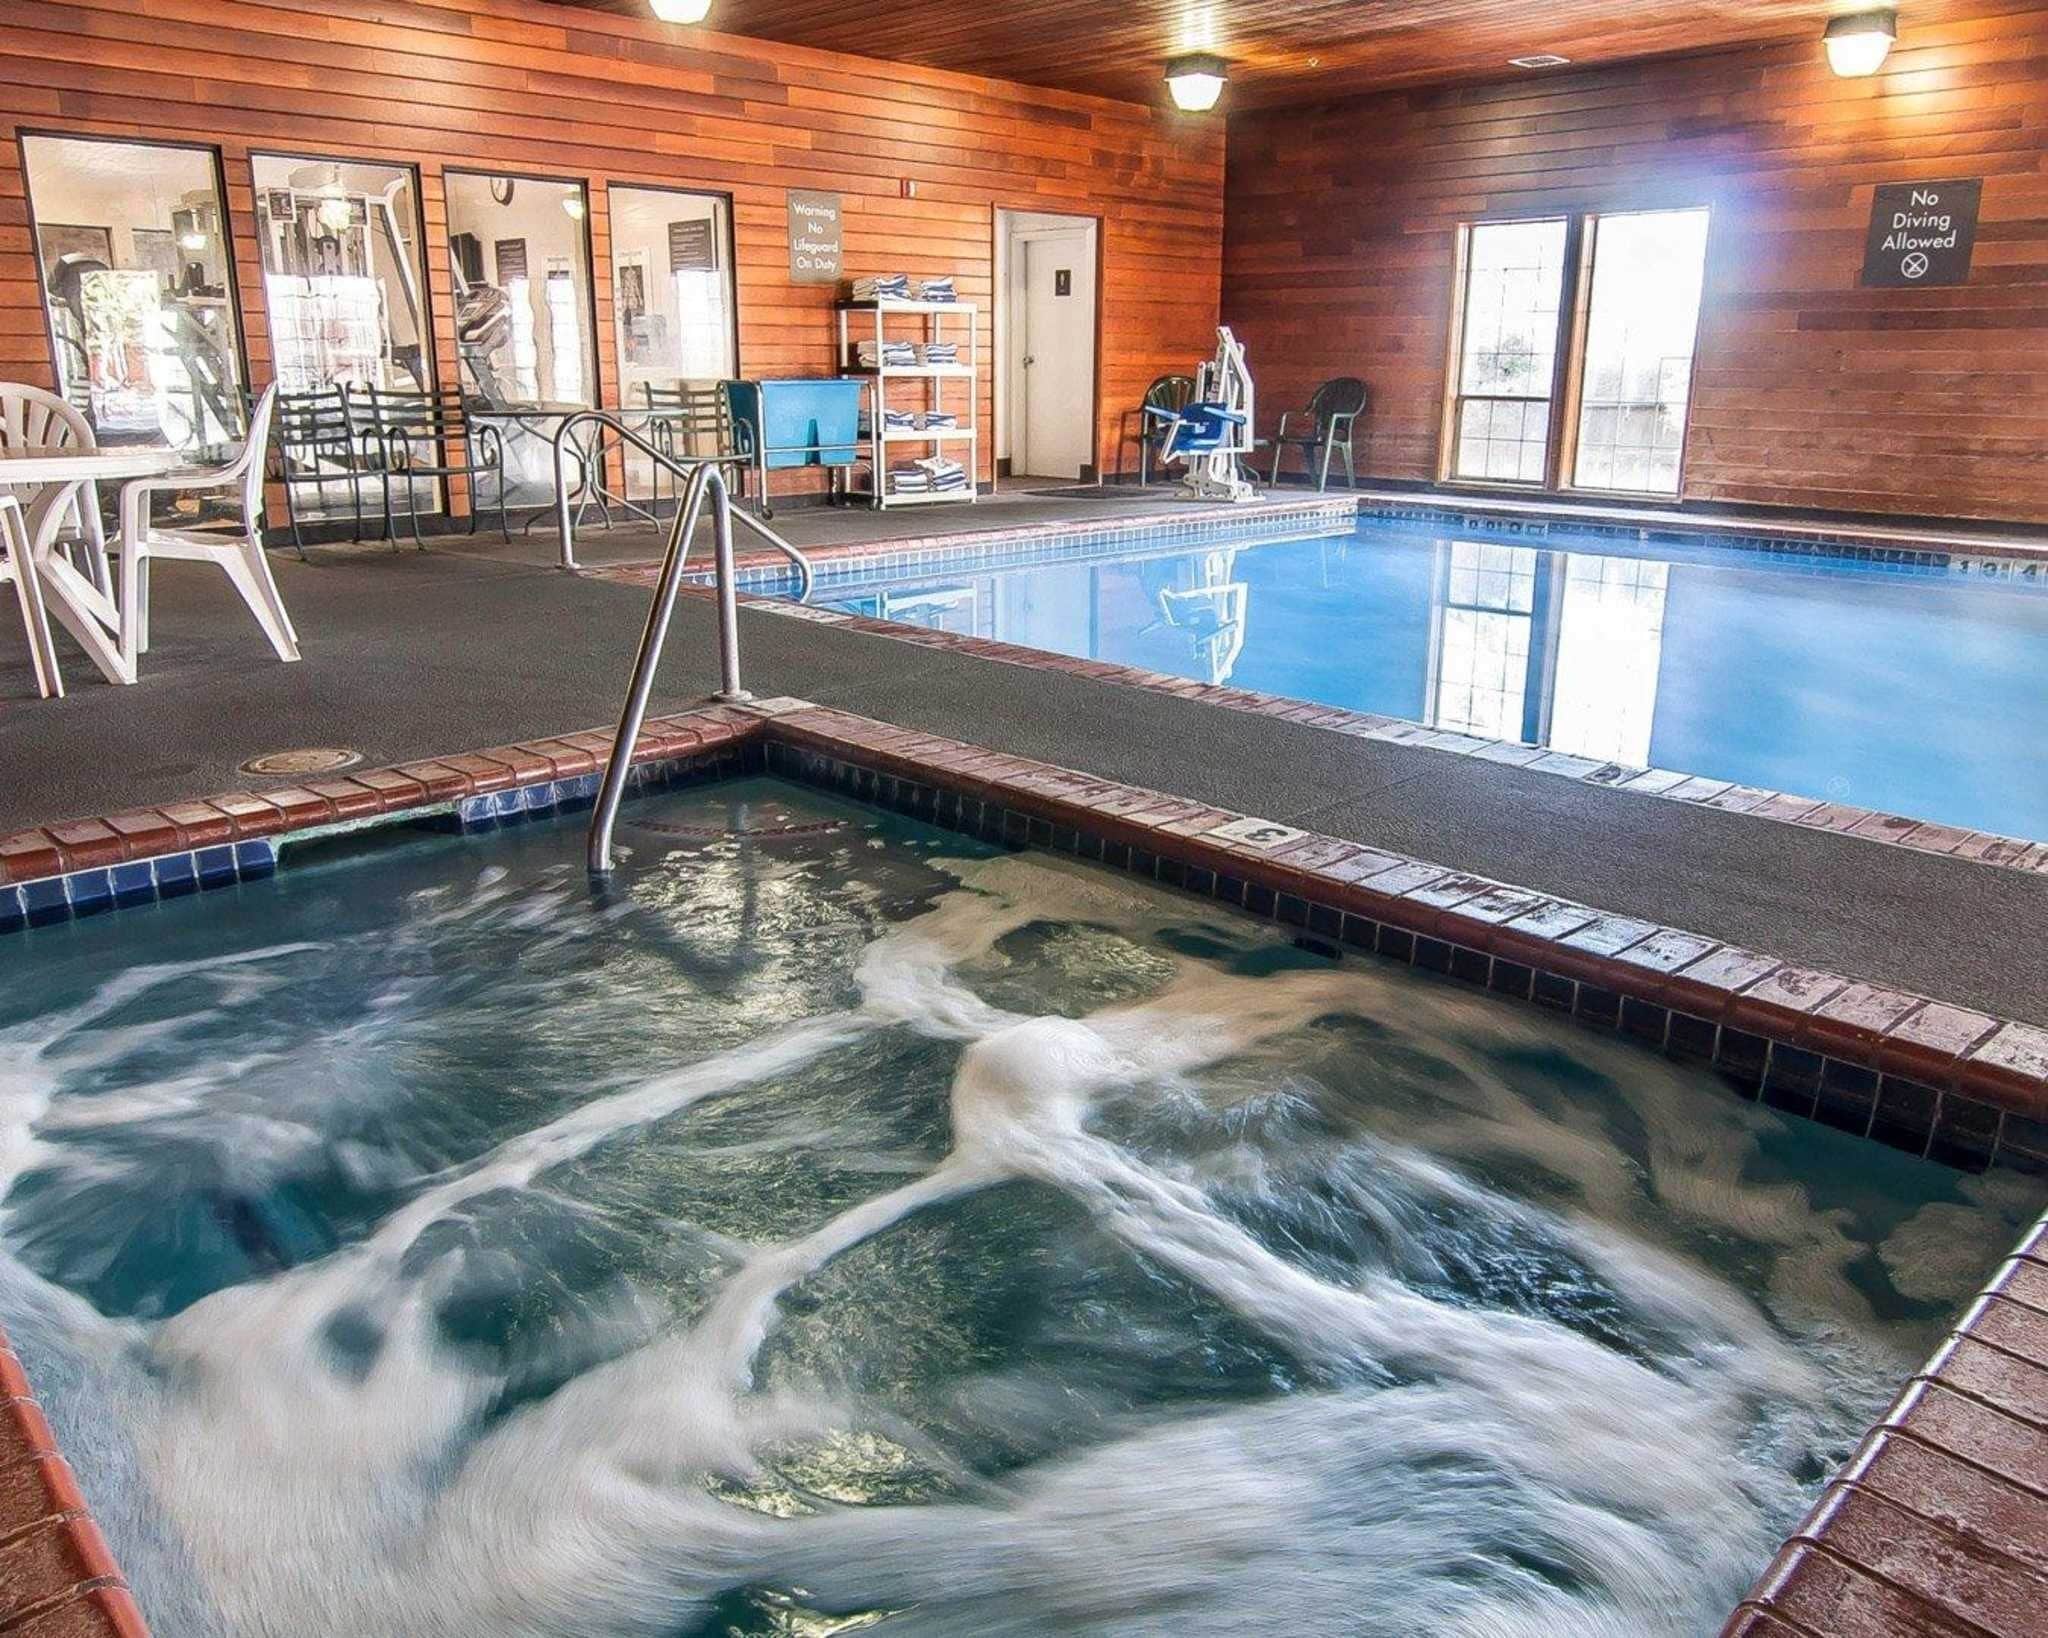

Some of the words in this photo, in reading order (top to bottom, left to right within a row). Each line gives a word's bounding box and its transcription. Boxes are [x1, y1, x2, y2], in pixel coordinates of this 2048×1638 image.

[1910, 189, 1939, 207] No
[792, 201, 836, 221] Warning
[807, 221, 823, 234] No
[1892, 211, 1951, 232] Diving
[793, 238, 839, 255] Lifeguard
[1880, 229, 1957, 251] Allowed
[796, 256, 813, 269] On
[815, 257, 837, 273] Duty
